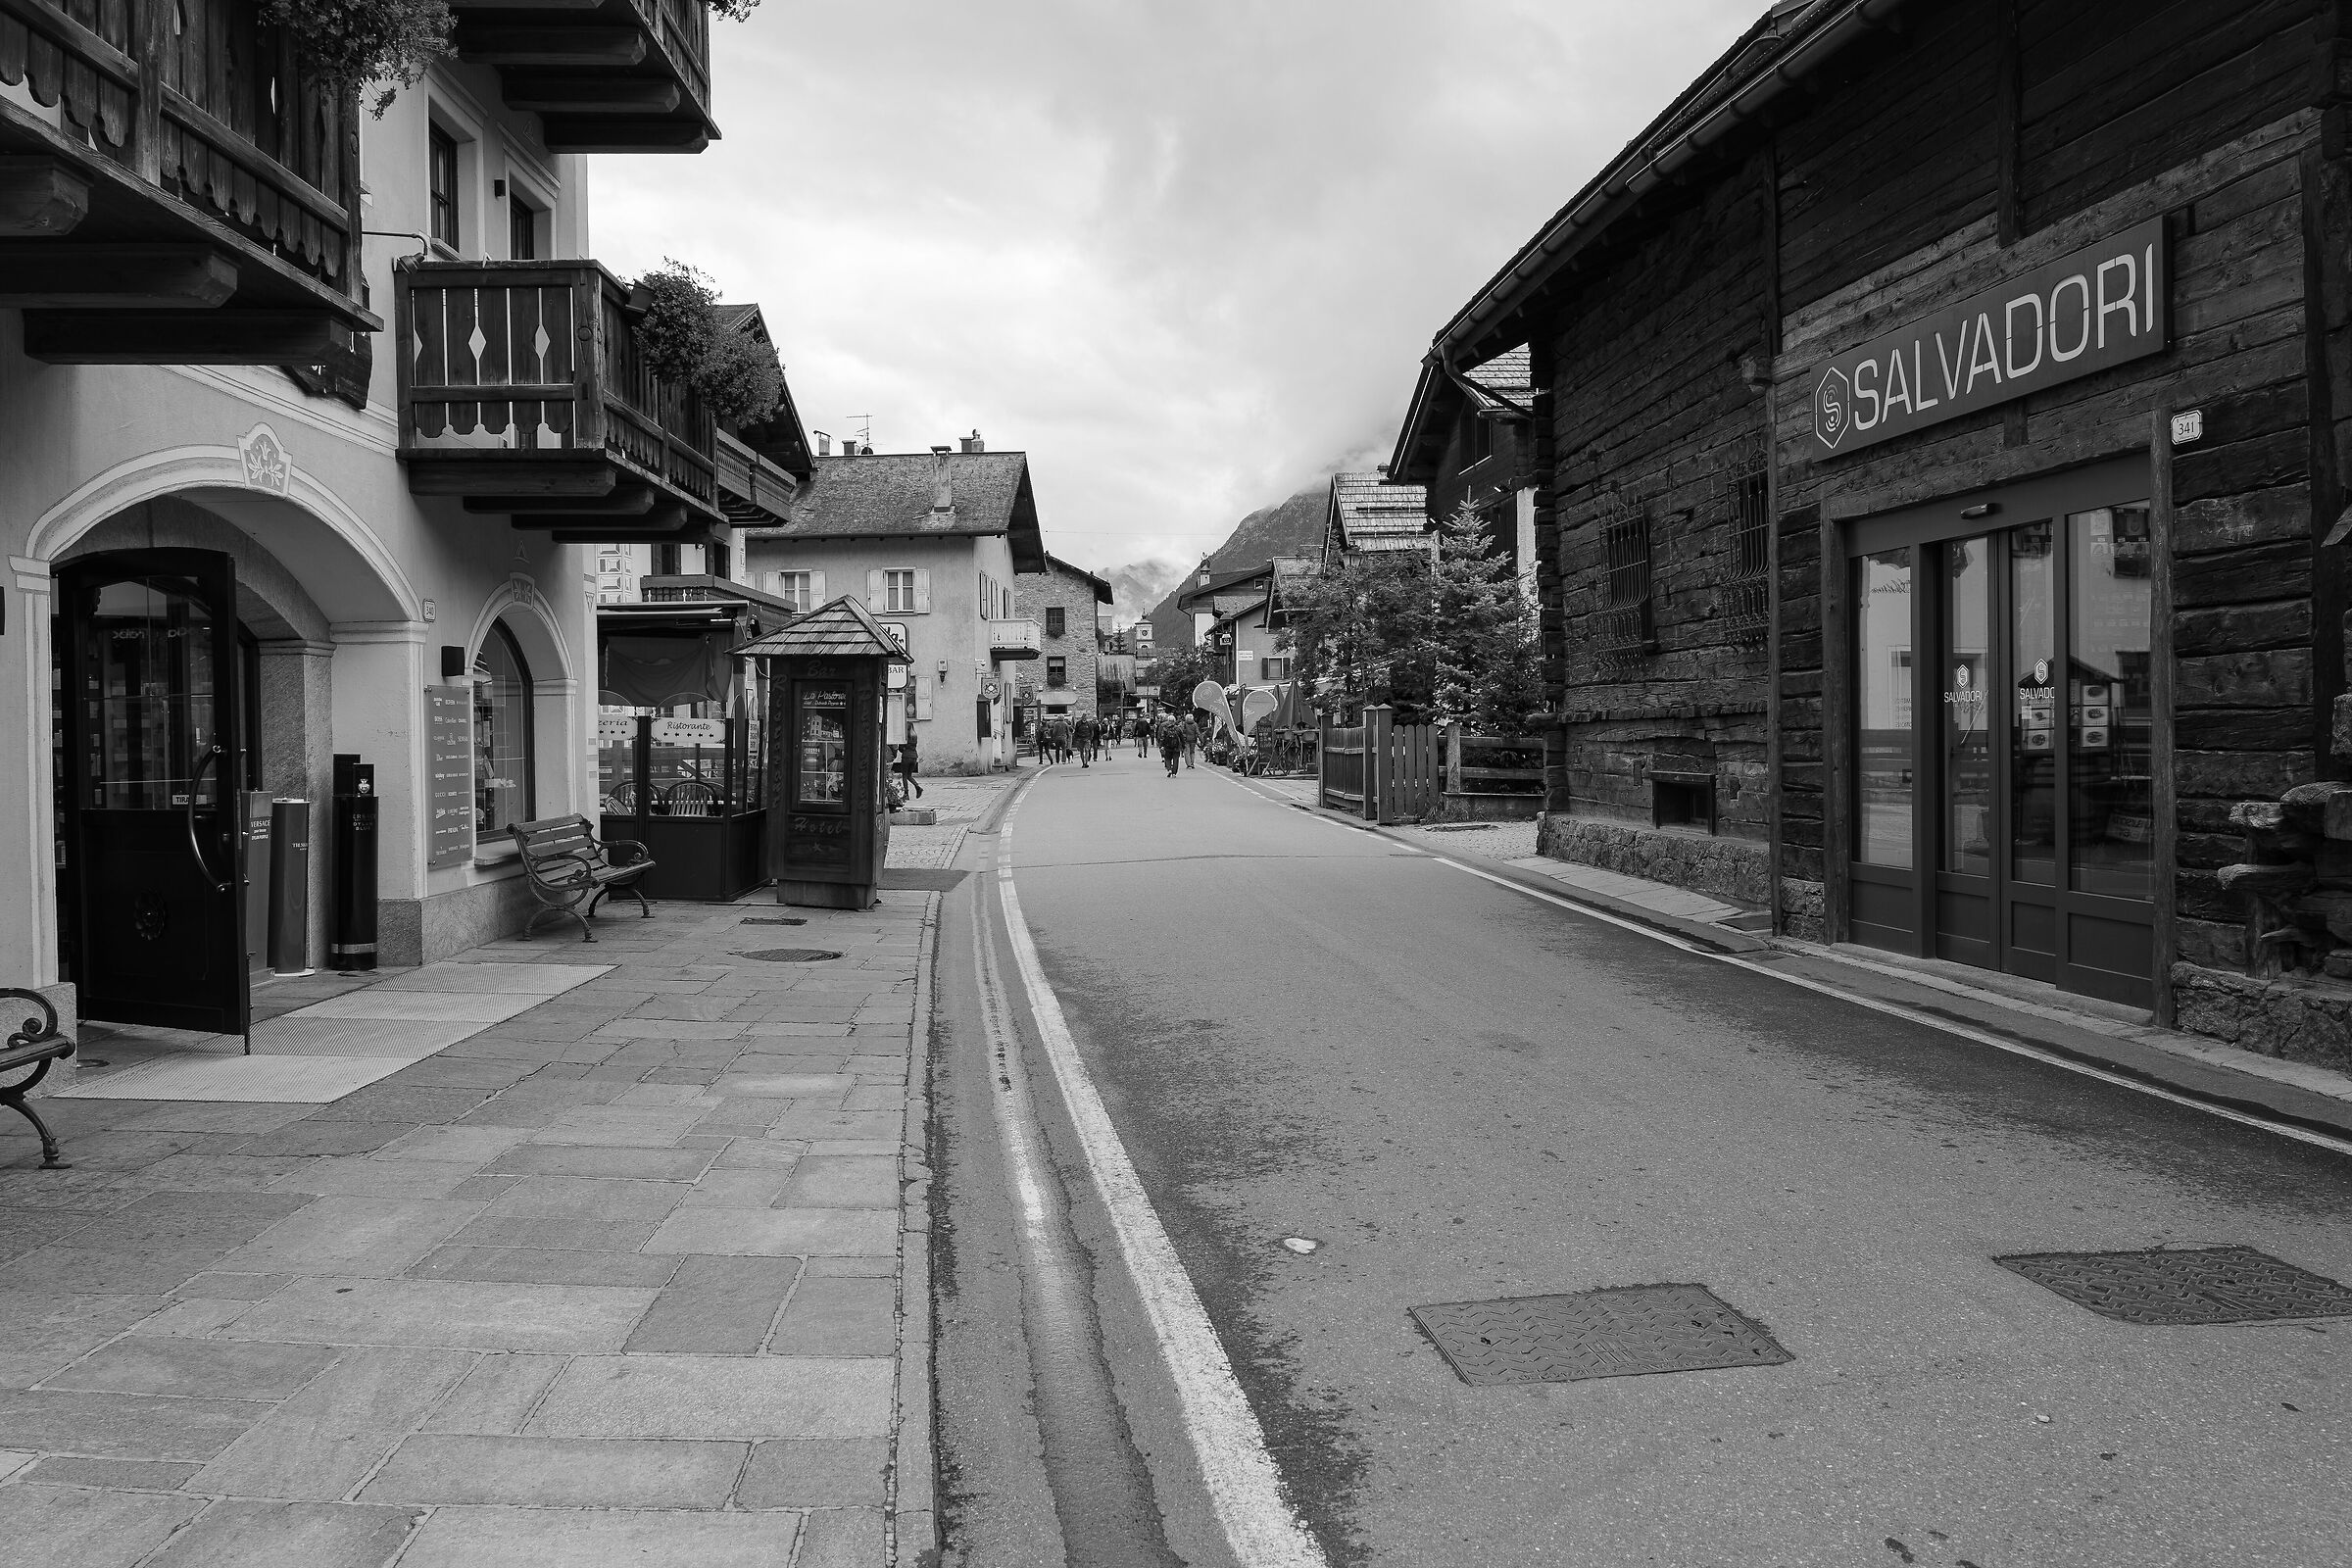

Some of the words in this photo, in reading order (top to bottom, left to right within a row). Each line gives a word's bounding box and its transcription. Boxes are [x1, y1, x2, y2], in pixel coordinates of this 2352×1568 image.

[1853, 243, 2154, 431] SALVADORI
[2178, 421, 2195, 436] 341
[807, 659, 839, 677] Bar
[666, 720, 712, 731] Ristorante
[250, 819, 271, 828] VERSACE
[793, 815, 843, 835] Hotel
